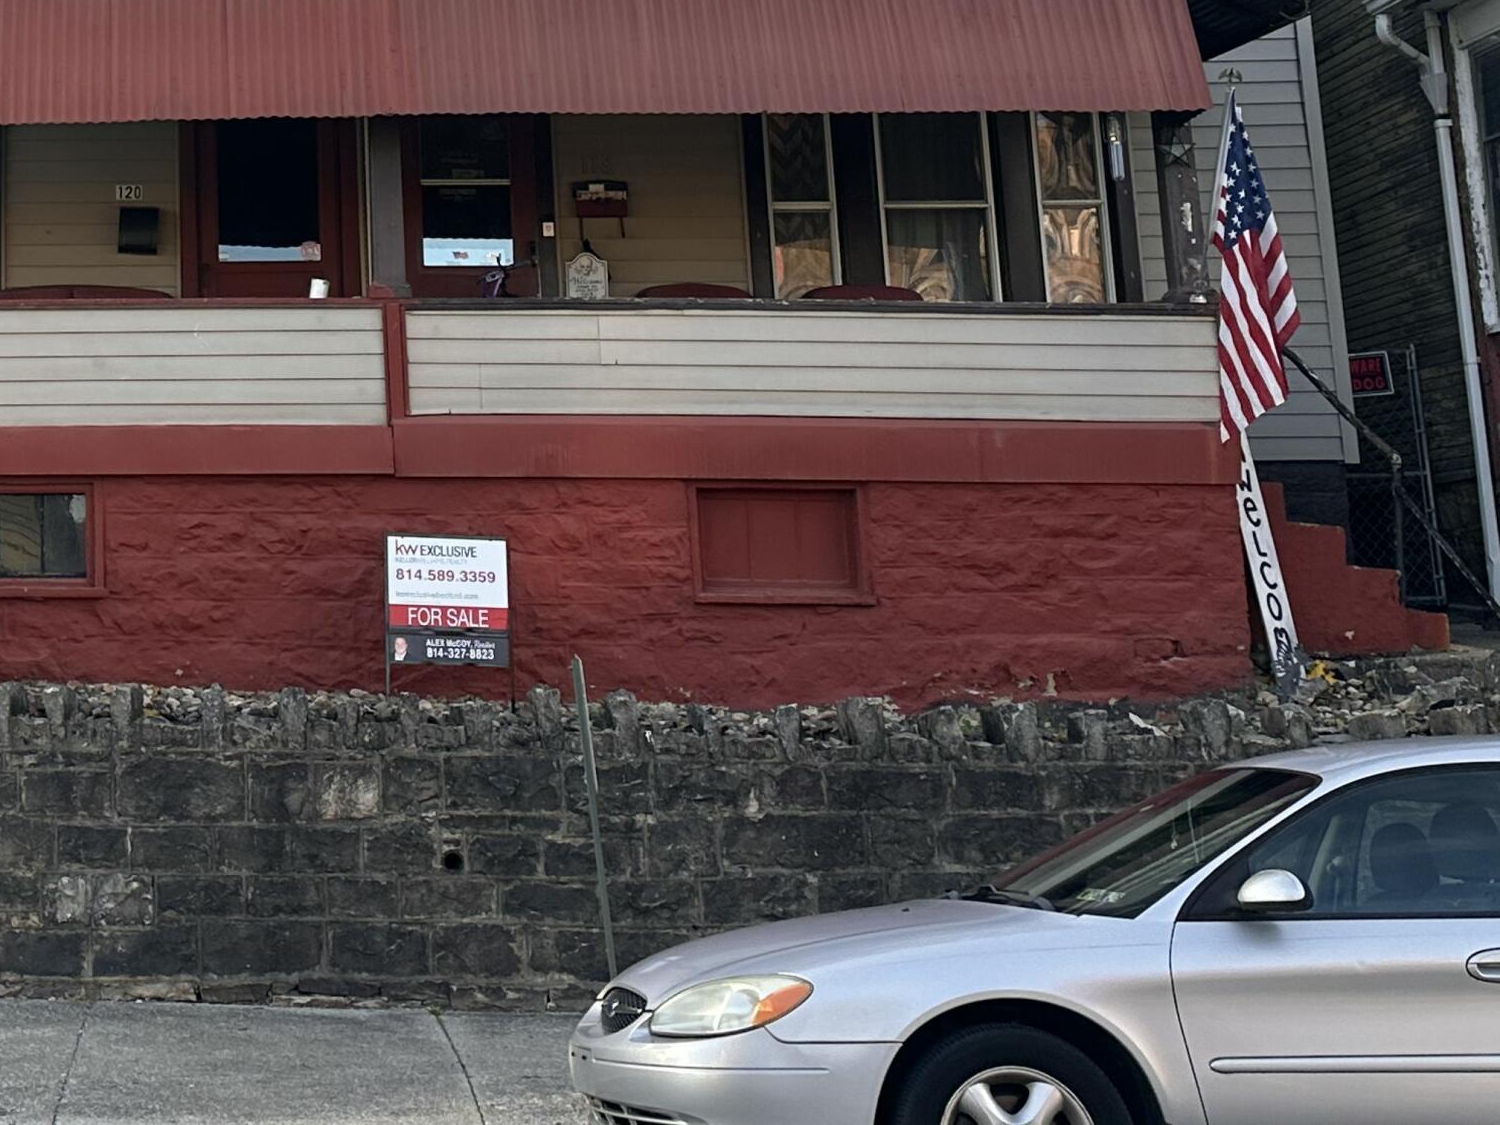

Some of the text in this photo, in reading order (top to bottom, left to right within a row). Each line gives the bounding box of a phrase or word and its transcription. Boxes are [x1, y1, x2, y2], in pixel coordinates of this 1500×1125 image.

[119, 185, 141, 199] 120
[1350, 357, 1382, 375] WARE
[1353, 376, 1386, 391] DOG
[420, 544, 477, 558] EXCLUSIVE
[395, 568, 496, 583] 814.589.3359
[408, 607, 489, 628] FOR SALE
[426, 638, 445, 647] ALEX
